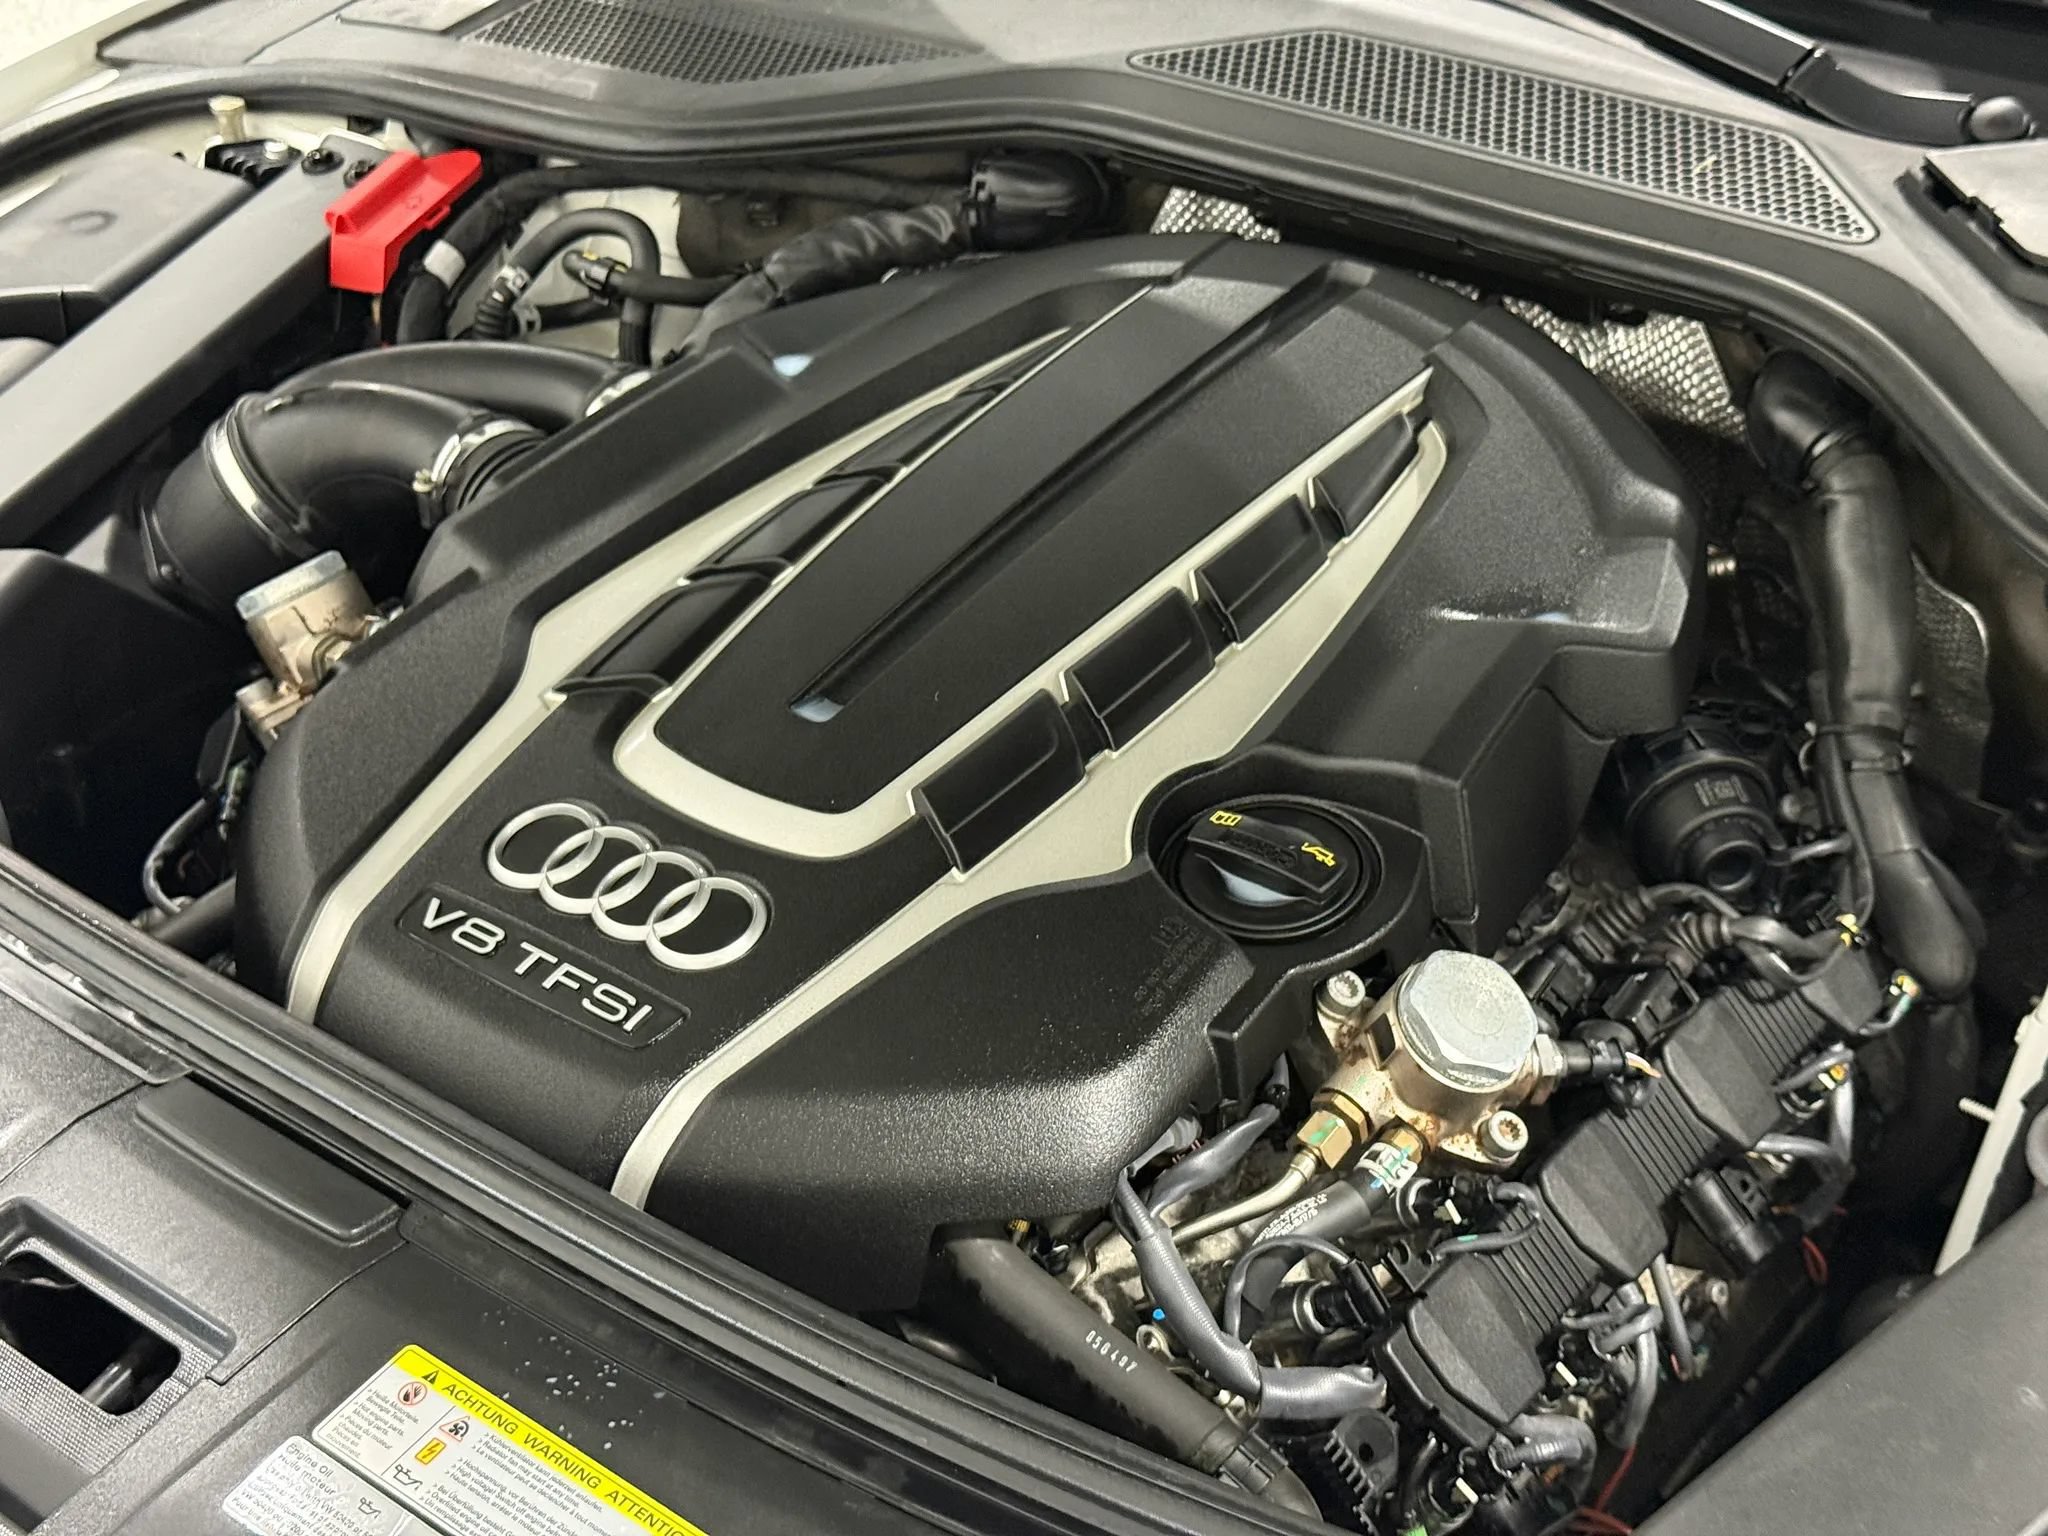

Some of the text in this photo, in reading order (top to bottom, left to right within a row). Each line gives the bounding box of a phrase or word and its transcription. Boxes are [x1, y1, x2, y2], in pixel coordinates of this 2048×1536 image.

[423, 897, 653, 1033] V8 TFSI
[352, 1408, 389, 1436] Moving parts.
[358, 1402, 404, 1437] Hot engine parts.
[362, 1428, 372, 1436] du
[370, 1434, 393, 1450] moteur
[442, 1383, 519, 1436] ACHTUNG
[522, 1433, 602, 1491] WARNING
[286, 1442, 334, 1478] Engine Oil
[482, 1440, 508, 1460] Radiator
[508, 1456, 518, 1467] fan
[518, 1464, 532, 1477] may
[531, 1474, 547, 1486] start
[552, 1488, 566, 1498] any
[534, 1464, 551, 1478] kann
[301, 1470, 336, 1495] moteur
[437, 1485, 449, 1496] Bei
[320, 1500, 336, 1514] VW
[456, 1465, 472, 1479] High
[515, 1506, 527, 1515] off
[524, 1513, 546, 1529] engine
[508, 1490, 520, 1500] vor
[546, 1516, 558, 1526] der
[459, 1512, 481, 1528] engine
[574, 1512, 589, 1524] tout
